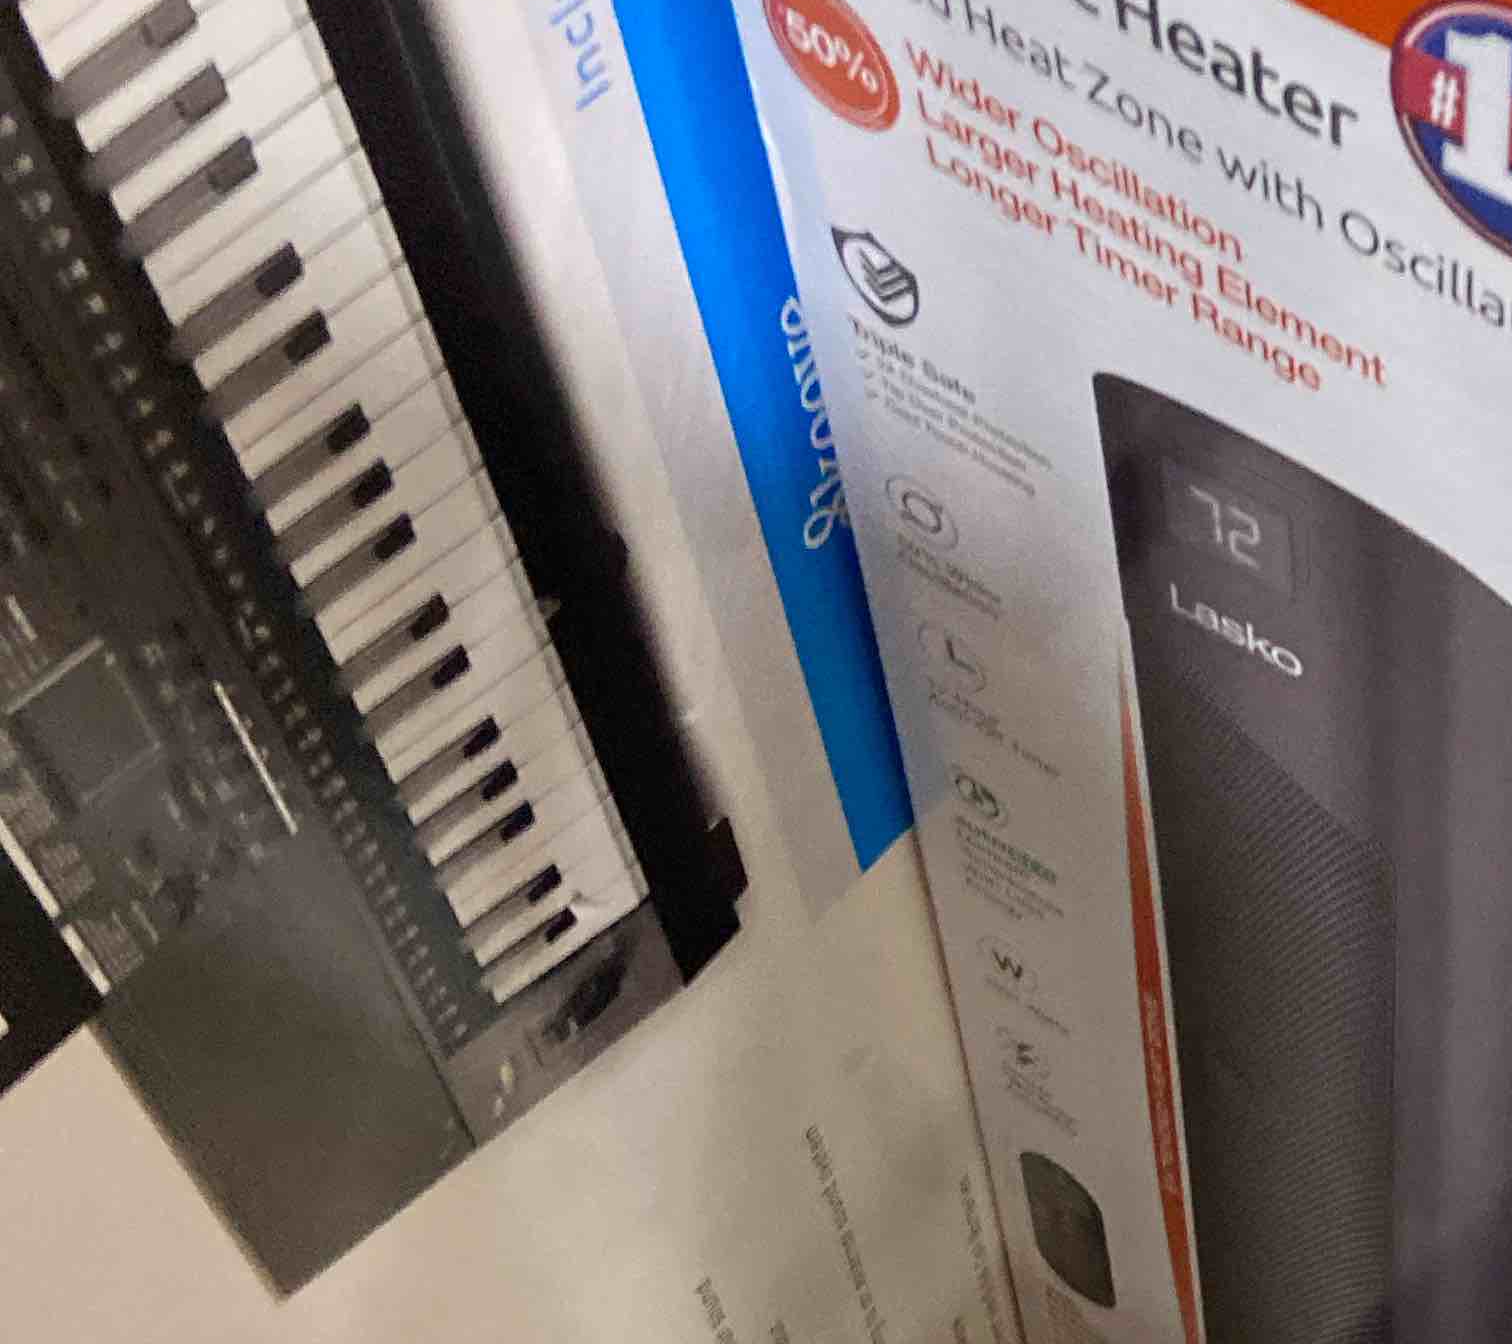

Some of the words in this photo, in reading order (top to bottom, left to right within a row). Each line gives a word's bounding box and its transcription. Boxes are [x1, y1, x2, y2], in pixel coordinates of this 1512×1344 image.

[781, 5, 881, 96] 50%
[903, 39, 1019, 135] Wider
[1032, 118, 1245, 262] Oscillation
[1086, 70, 1203, 159] Zone
[1216, 143, 1325, 232] with
[915, 88, 1038, 189] Larger
[1049, 166, 1205, 289] Heating
[1215, 266, 1389, 389] Element
[925, 135, 1055, 239] Longer
[1071, 223, 1180, 308] Timer
[1192, 291, 1322, 393] Range
[1188, 484, 1261, 570] 72
[1169, 581, 1303, 678] Lasko
